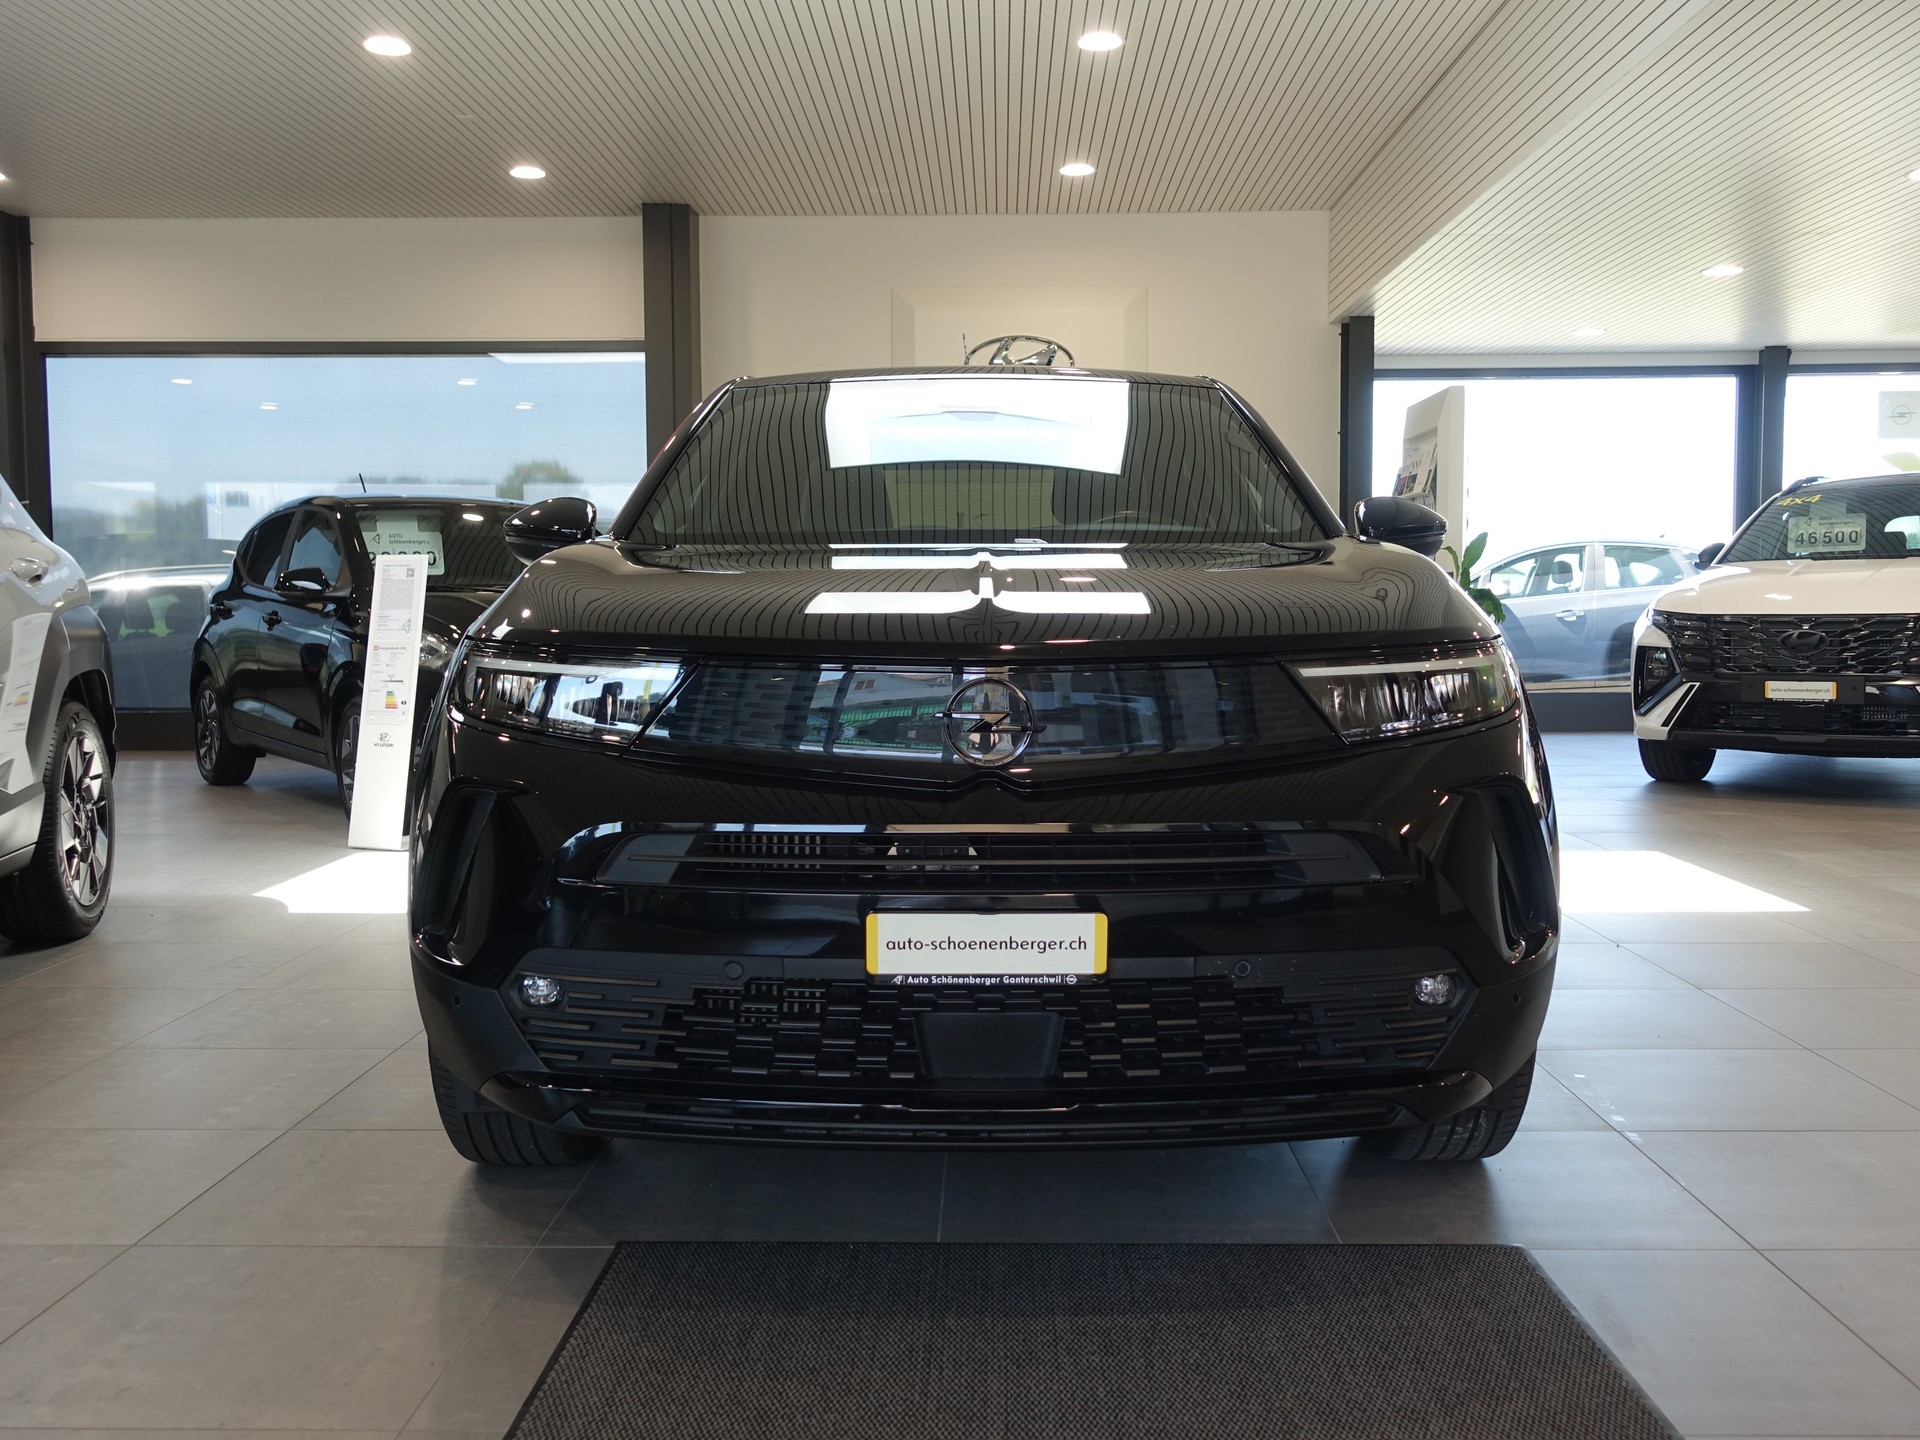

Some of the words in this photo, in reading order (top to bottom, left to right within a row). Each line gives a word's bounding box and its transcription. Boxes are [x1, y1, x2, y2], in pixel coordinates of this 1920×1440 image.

[1795, 530, 1859, 546] 46500
[886, 936, 1087, 954] auto-schoenenberger.ch
[907, 975, 929, 984] Auto
[931, 975, 1001, 986] Schönenberger
[1003, 975, 1062, 985] Ganterschwil
